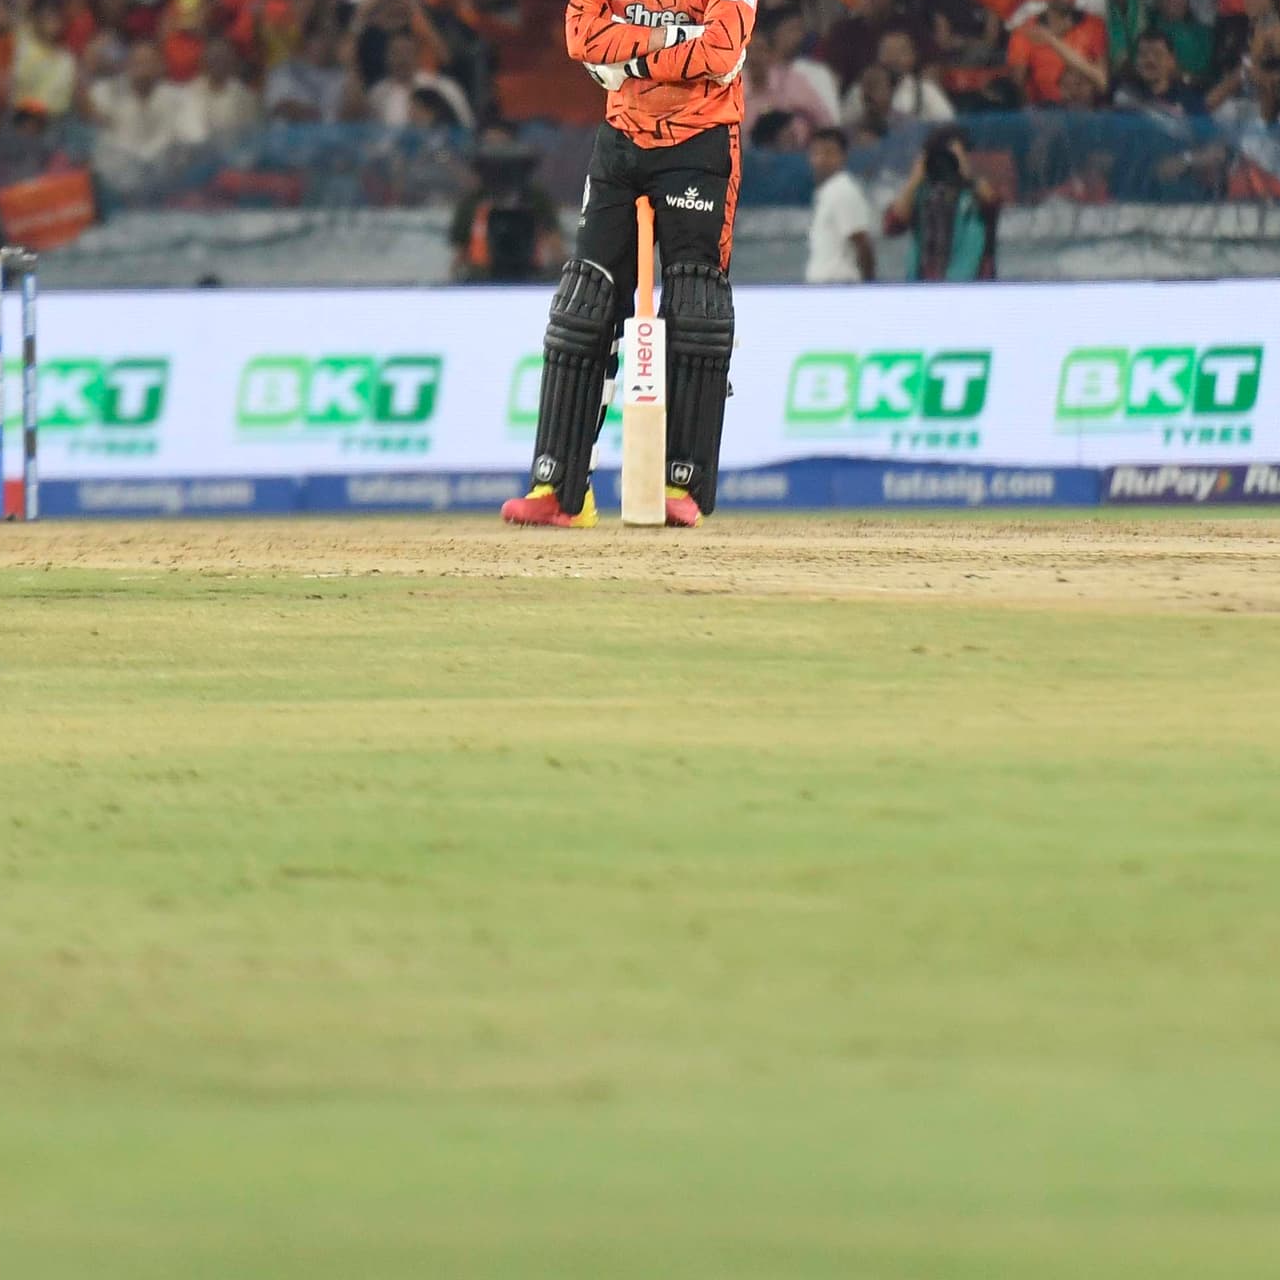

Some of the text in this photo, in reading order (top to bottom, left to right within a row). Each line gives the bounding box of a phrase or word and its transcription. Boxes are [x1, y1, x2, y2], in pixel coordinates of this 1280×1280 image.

[625, 3, 690, 27] Shree
[665, 194, 714, 212] WROGN
[637, 322, 653, 377] Hero
[237, 356, 442, 426] BKT
[786, 351, 991, 422] BKT
[1056, 345, 1262, 418] BKT
[1162, 426, 1254, 446] TYRES
[1110, 466, 1219, 501] RuPay
